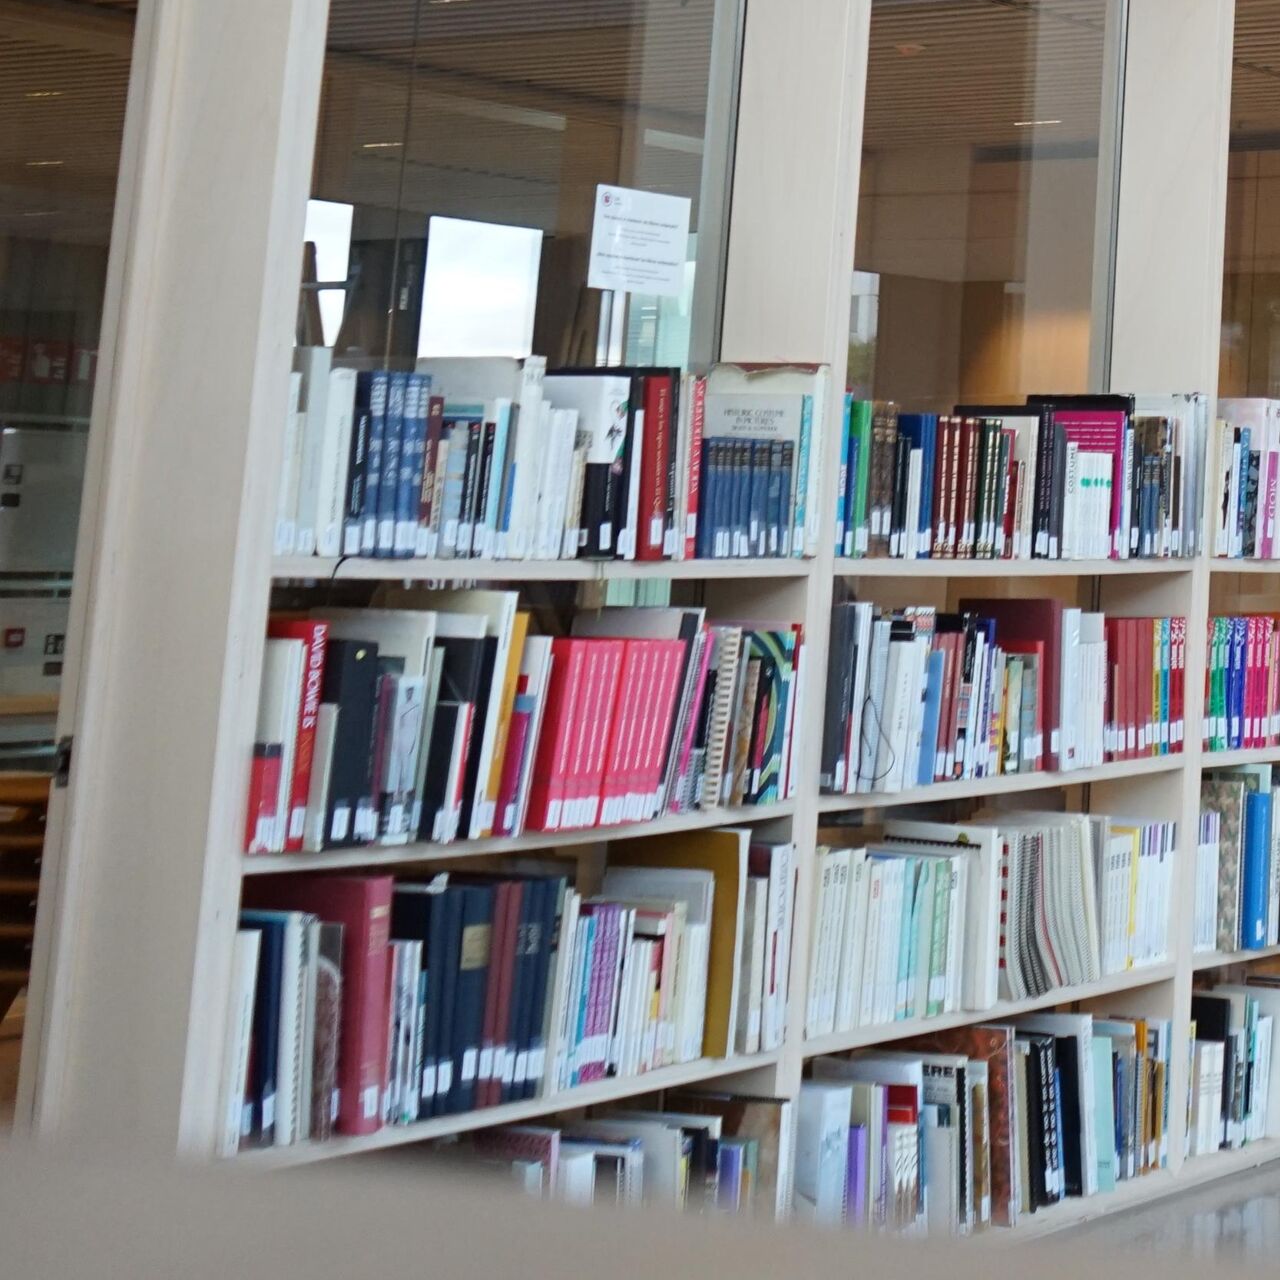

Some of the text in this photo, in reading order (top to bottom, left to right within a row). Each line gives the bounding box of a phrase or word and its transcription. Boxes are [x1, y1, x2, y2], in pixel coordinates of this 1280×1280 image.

[1067, 445, 1077, 494] COSTUME
[311, 624, 327, 669] DAVID
[304, 669, 321, 715] BOWIE
[302, 715, 316, 729] IS
